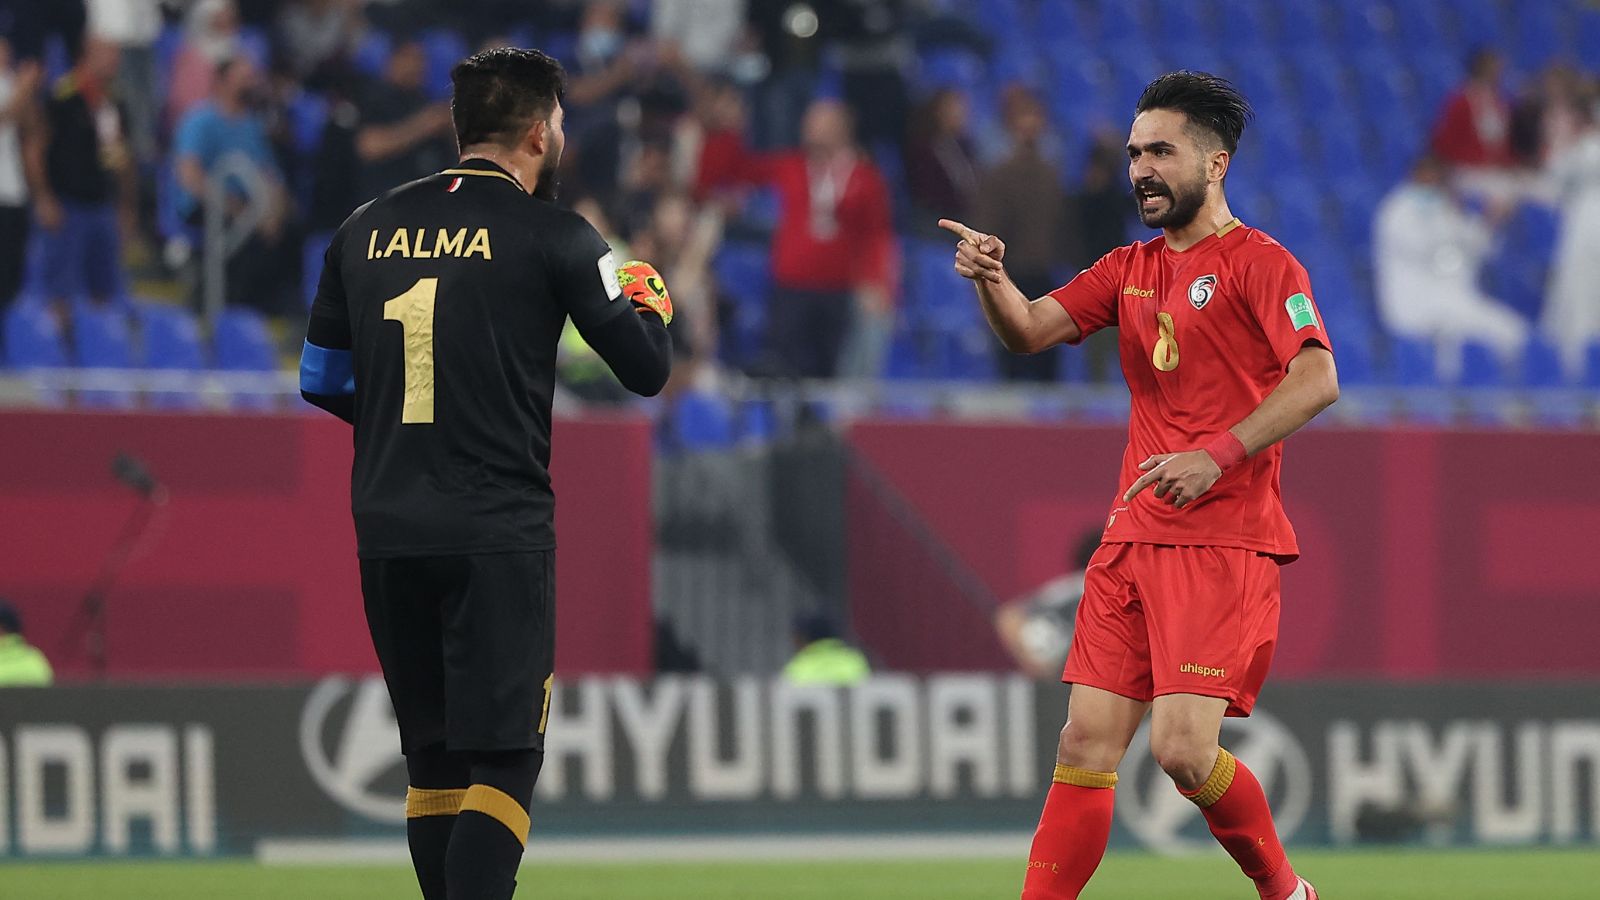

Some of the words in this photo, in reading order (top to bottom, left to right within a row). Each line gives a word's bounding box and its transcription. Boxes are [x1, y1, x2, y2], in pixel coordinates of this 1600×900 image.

[368, 228, 492, 260] I.ALMA
[383, 278, 439, 424] 1
[1152, 312, 1180, 372] 8
[1180, 662, 1225, 678] uhlsport
[533, 673, 1038, 801] HYUNDAI
[0, 724, 214, 853] DAI
